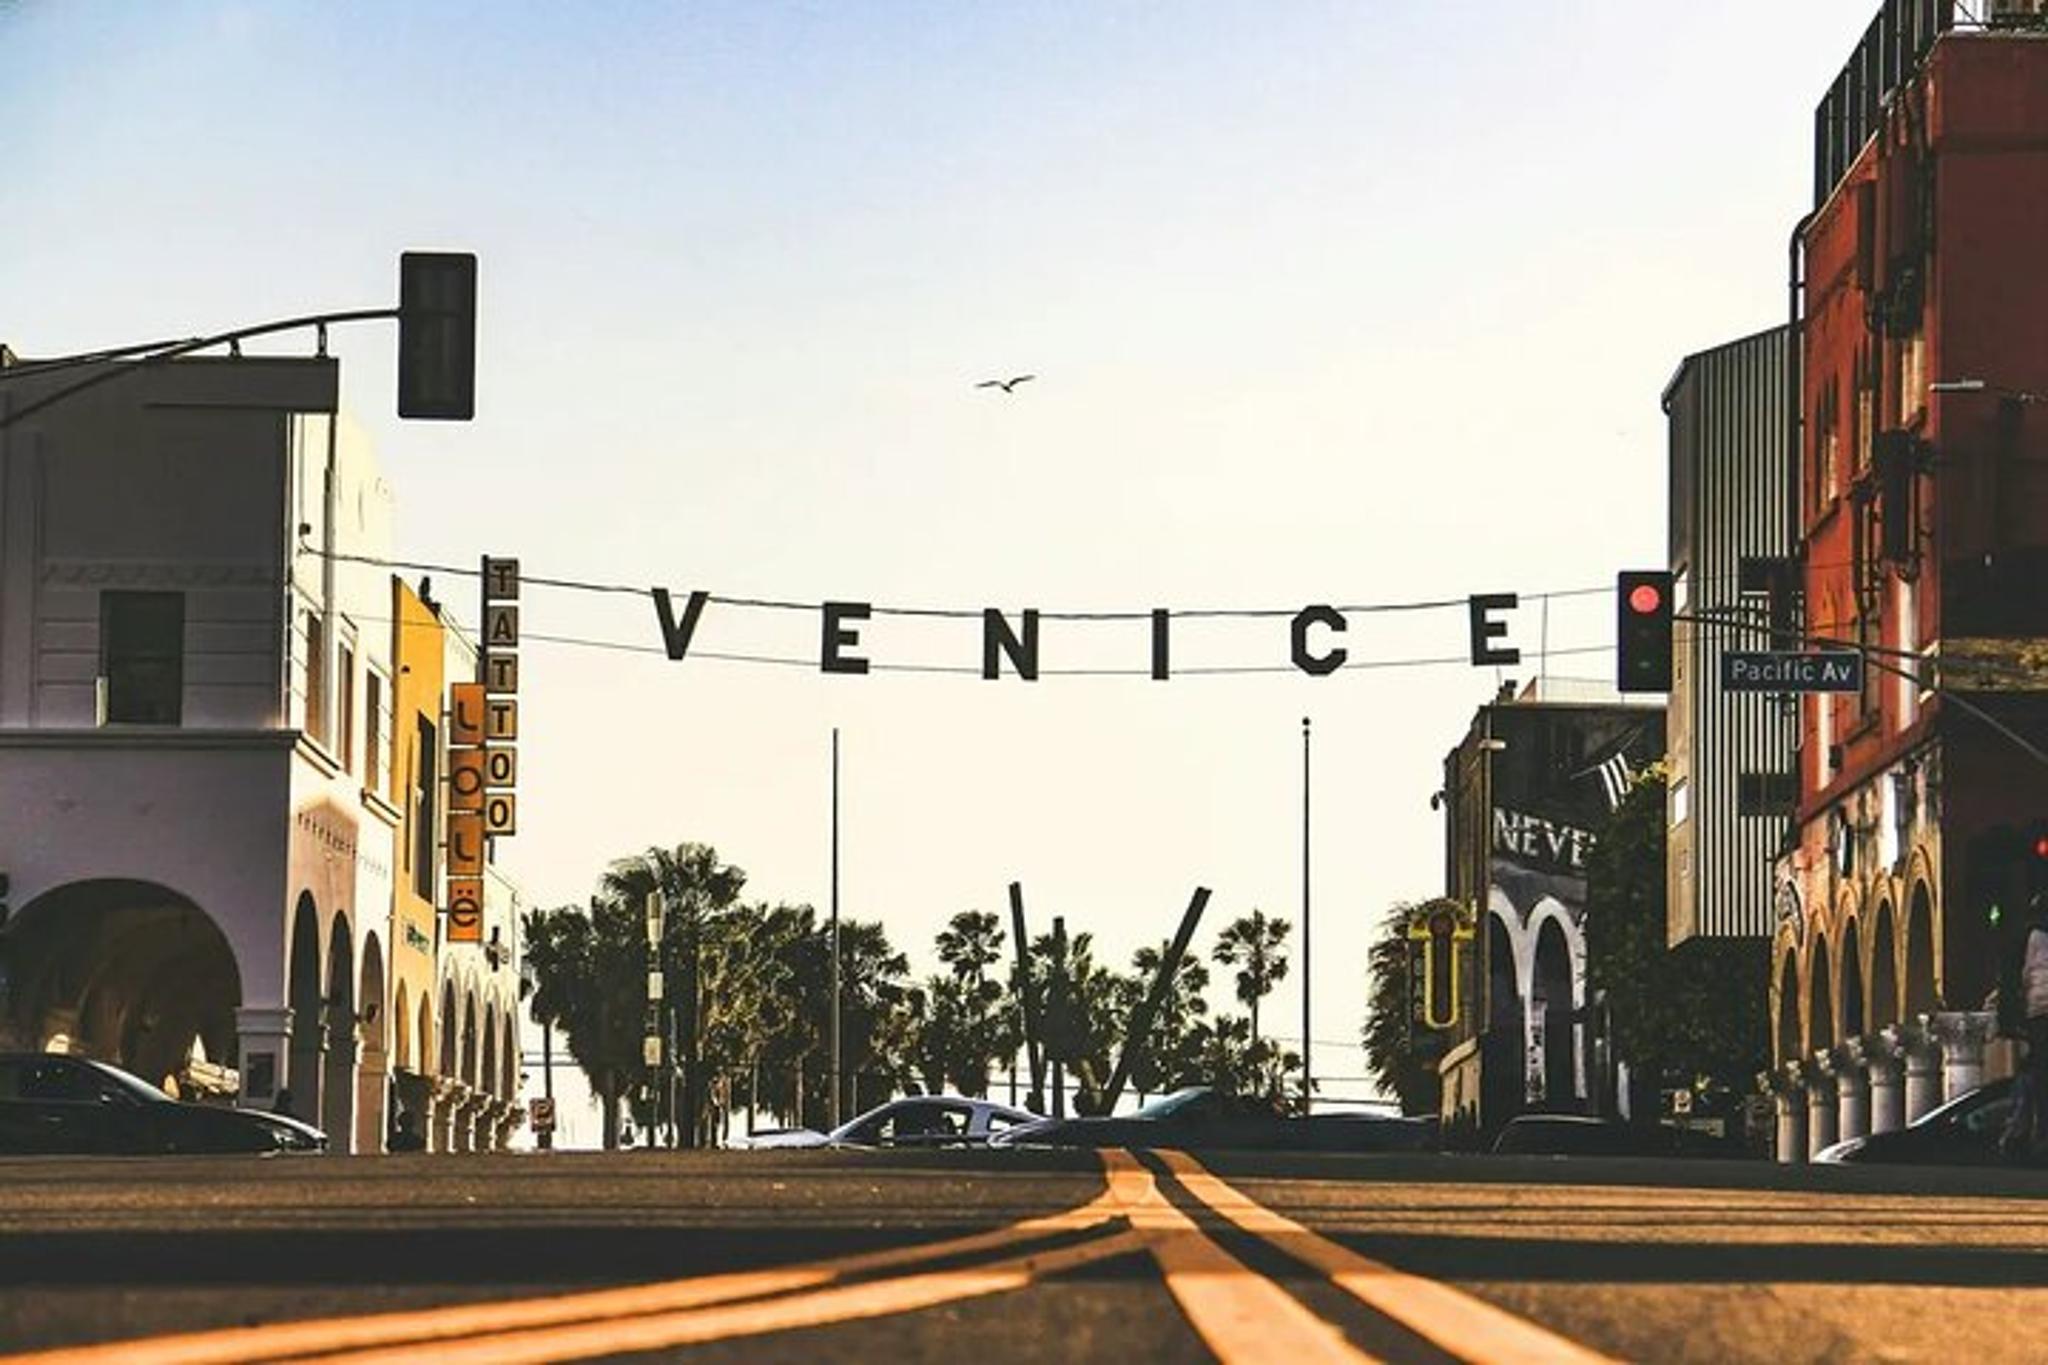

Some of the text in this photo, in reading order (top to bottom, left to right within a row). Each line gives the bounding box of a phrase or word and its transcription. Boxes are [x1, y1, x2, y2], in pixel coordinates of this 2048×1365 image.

[652, 588, 1520, 681] VENICE
[1731, 659, 1850, 681] Pacific Av
[488, 565, 514, 826] TATTOO
